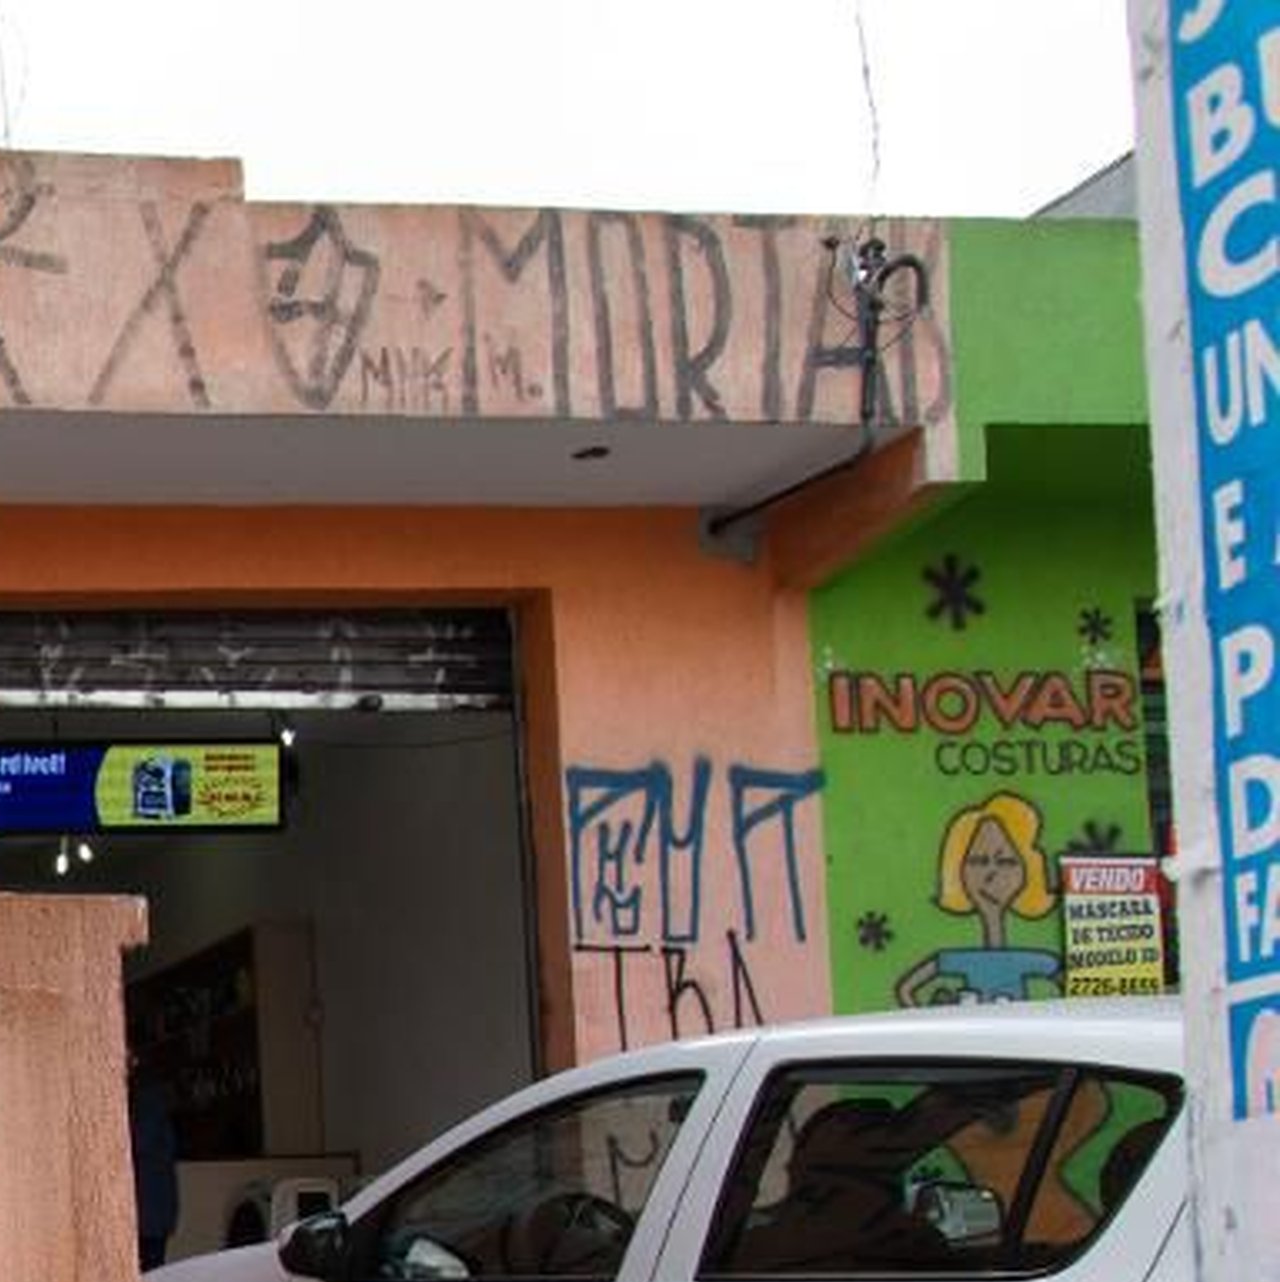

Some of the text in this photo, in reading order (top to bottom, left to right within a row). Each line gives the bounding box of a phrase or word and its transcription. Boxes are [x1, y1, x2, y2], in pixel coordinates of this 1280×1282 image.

[828, 669, 1139, 735] INOVAR
[935, 740, 1142, 776] COSTURAS
[1070, 866, 1145, 893] VENDO
[1097, 923, 1155, 943] TECIDO
[1069, 948, 1137, 969] MODELO
